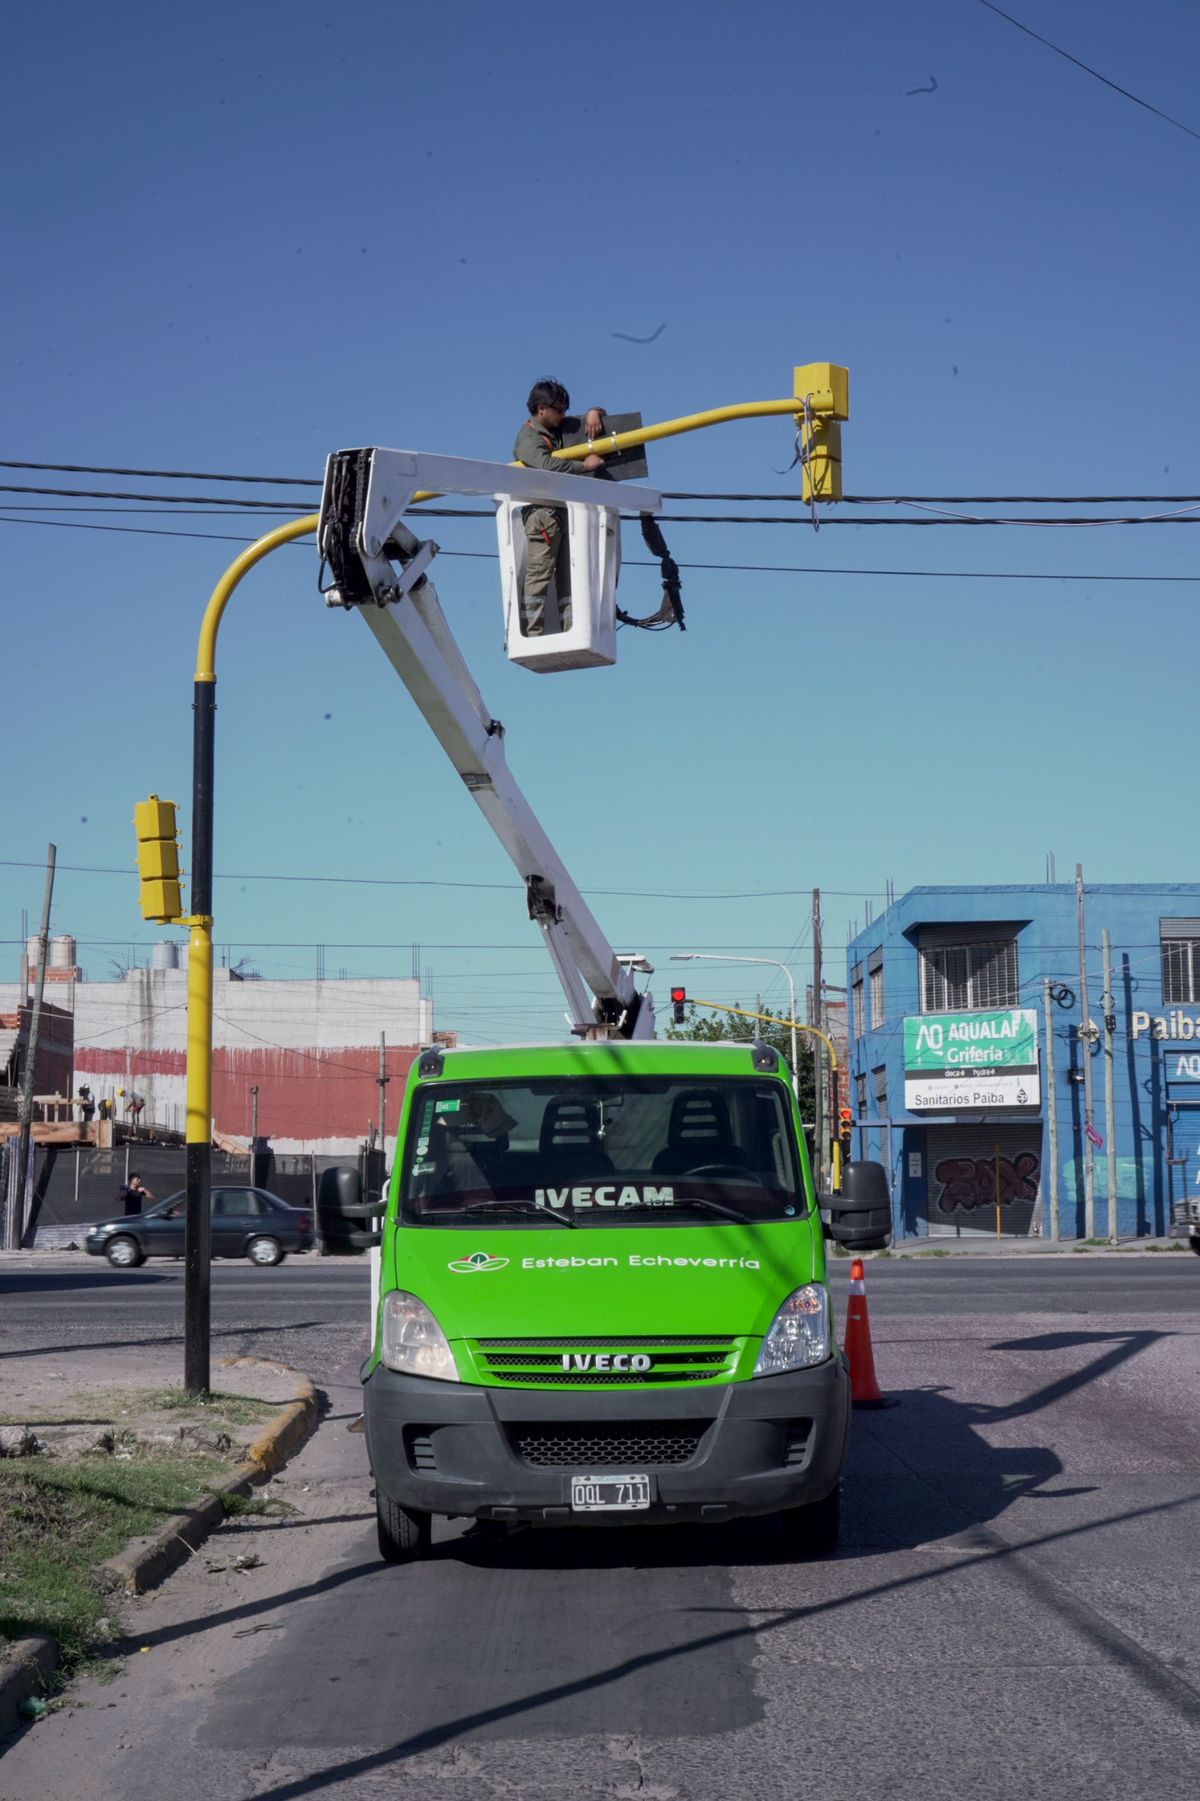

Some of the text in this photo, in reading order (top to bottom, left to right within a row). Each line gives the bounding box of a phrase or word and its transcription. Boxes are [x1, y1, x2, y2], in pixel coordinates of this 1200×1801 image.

[1132, 1009, 1200, 1041] Paib
[947, 1045, 1004, 1063] Grifería
[914, 1092, 1005, 1106] Sanitarios Paiba
[534, 1186, 675, 1209] IVECAM
[522, 1255, 760, 1269] Esteban Echeverría
[562, 1354, 651, 1371] IVECO
[575, 1484, 647, 1504] OQL 711
